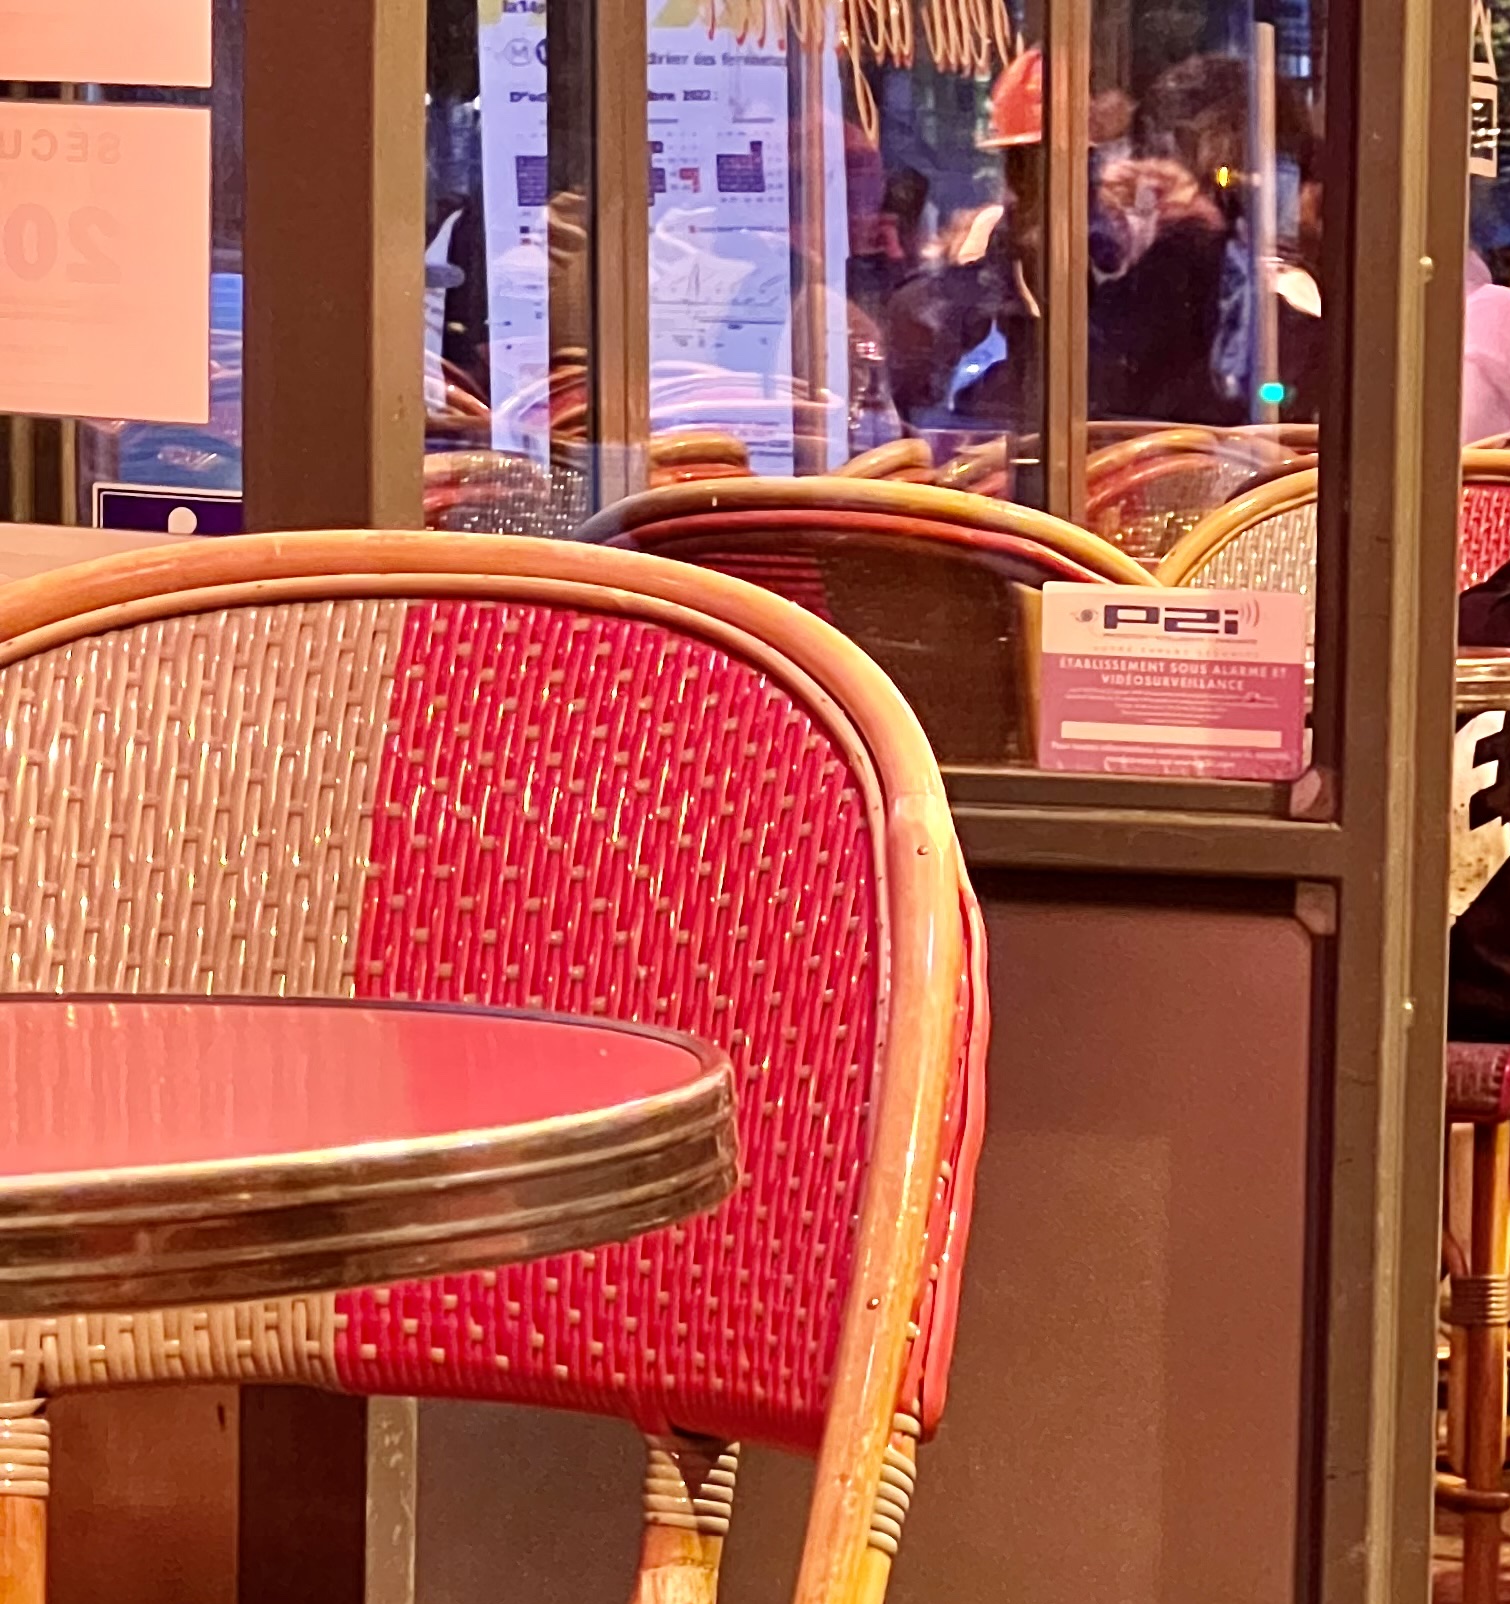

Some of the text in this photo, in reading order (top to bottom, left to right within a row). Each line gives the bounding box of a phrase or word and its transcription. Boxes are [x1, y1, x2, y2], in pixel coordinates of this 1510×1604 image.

[1059, 656, 1288, 680] ÉTABLISSEMENT SOUS ALARME ET
[1101, 673, 1245, 692] VIDÉOSURVEILLANCE
